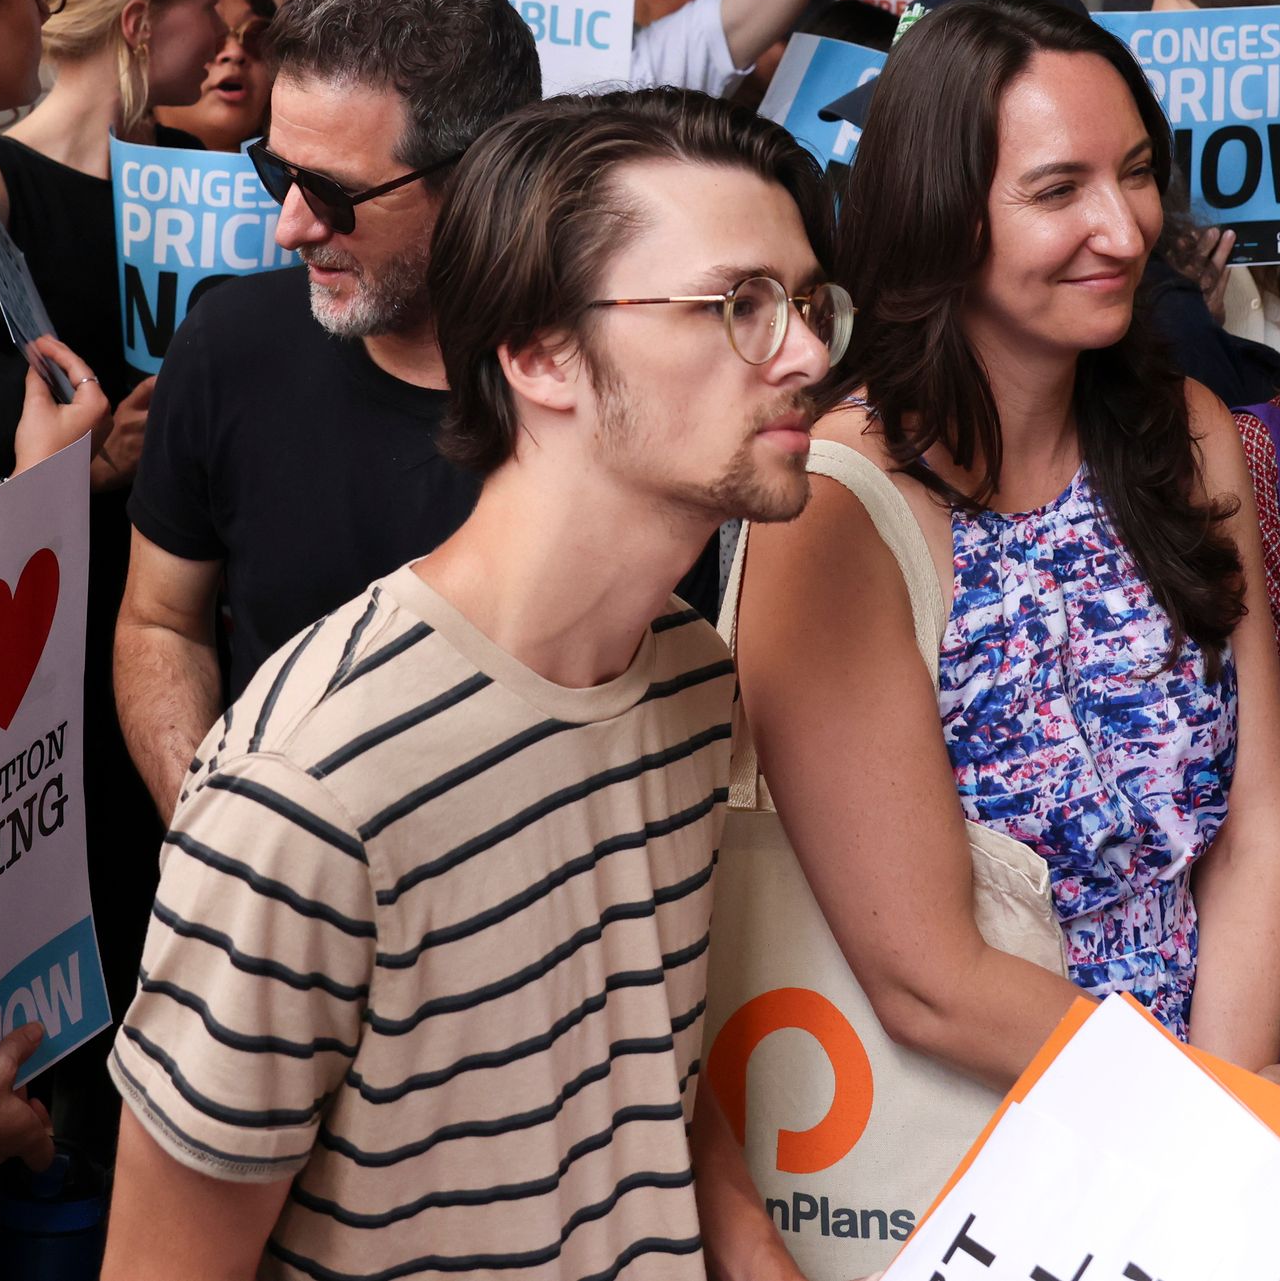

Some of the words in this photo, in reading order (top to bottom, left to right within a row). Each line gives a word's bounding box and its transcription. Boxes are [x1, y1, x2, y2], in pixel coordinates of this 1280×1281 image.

[511, 0, 611, 51] BLIC
[124, 262, 240, 359] N
[765, 1191, 917, 1242] nPlans
